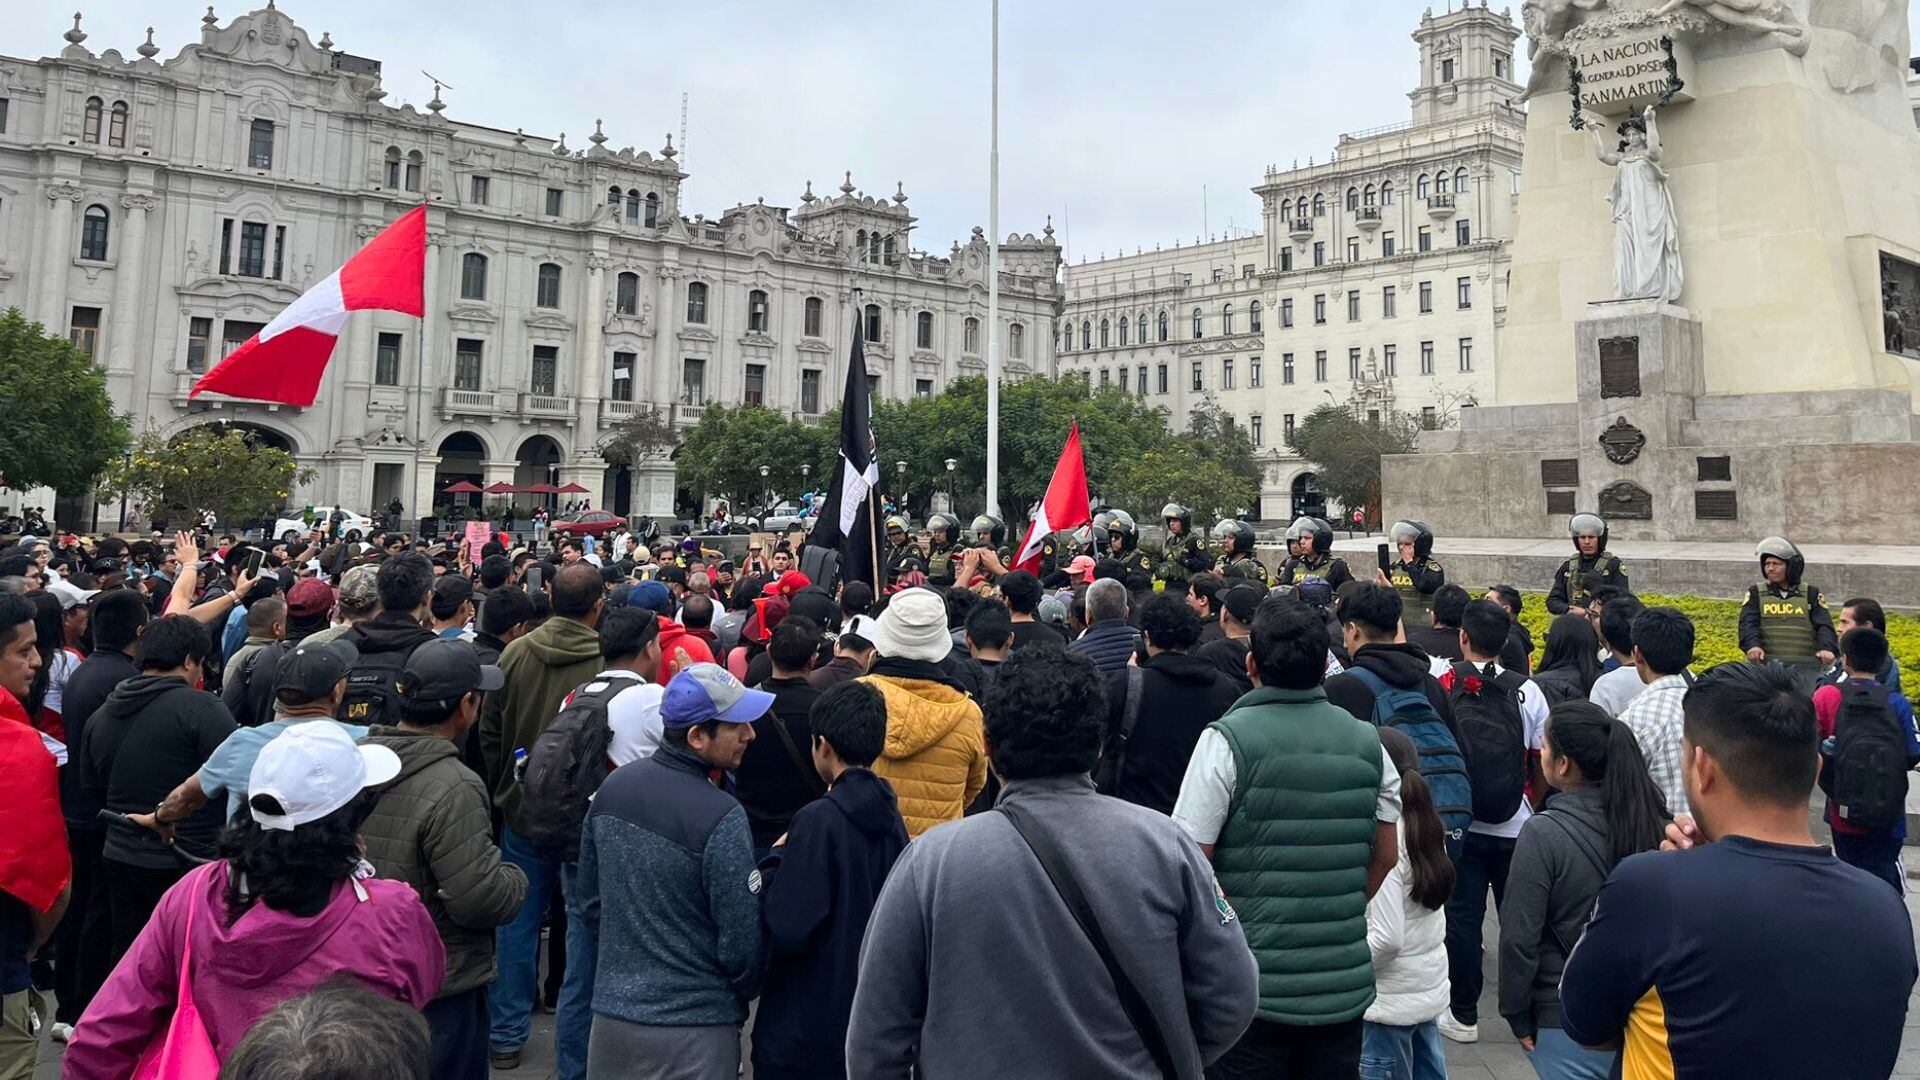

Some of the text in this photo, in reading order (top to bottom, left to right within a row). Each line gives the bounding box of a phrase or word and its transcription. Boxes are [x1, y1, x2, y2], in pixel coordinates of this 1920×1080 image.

[1581, 39, 1659, 67] LA NACION
[1587, 69, 1627, 83] GENERAL
[348, 702, 369, 718] CAT
